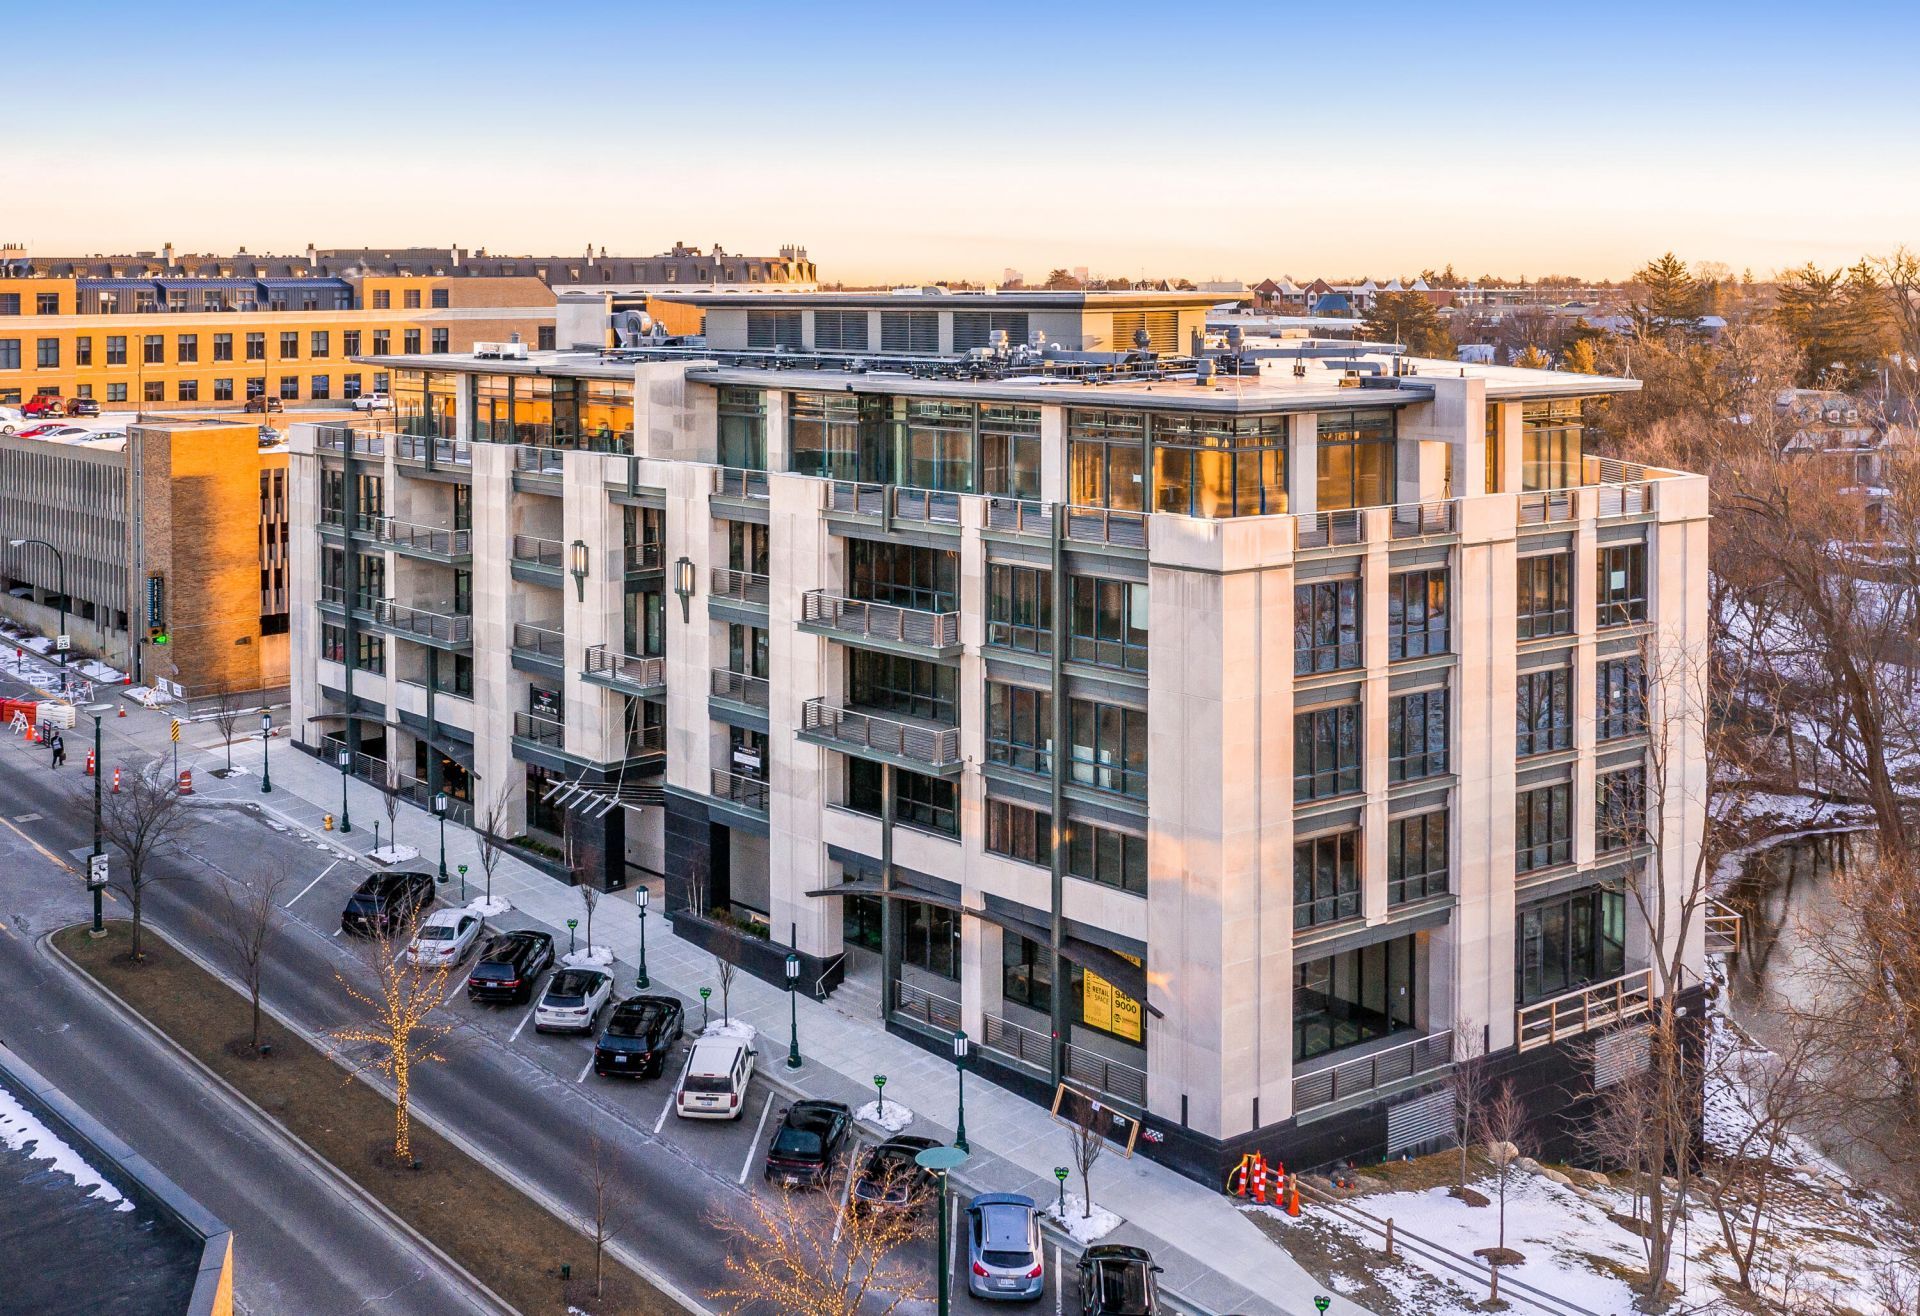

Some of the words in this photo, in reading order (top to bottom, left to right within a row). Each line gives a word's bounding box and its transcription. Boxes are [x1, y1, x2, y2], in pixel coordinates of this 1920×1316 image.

[1092, 986, 1110, 998] RETAIL
[1094, 994, 1110, 1005] SPACE
[1115, 1000, 1137, 1014] 9000
